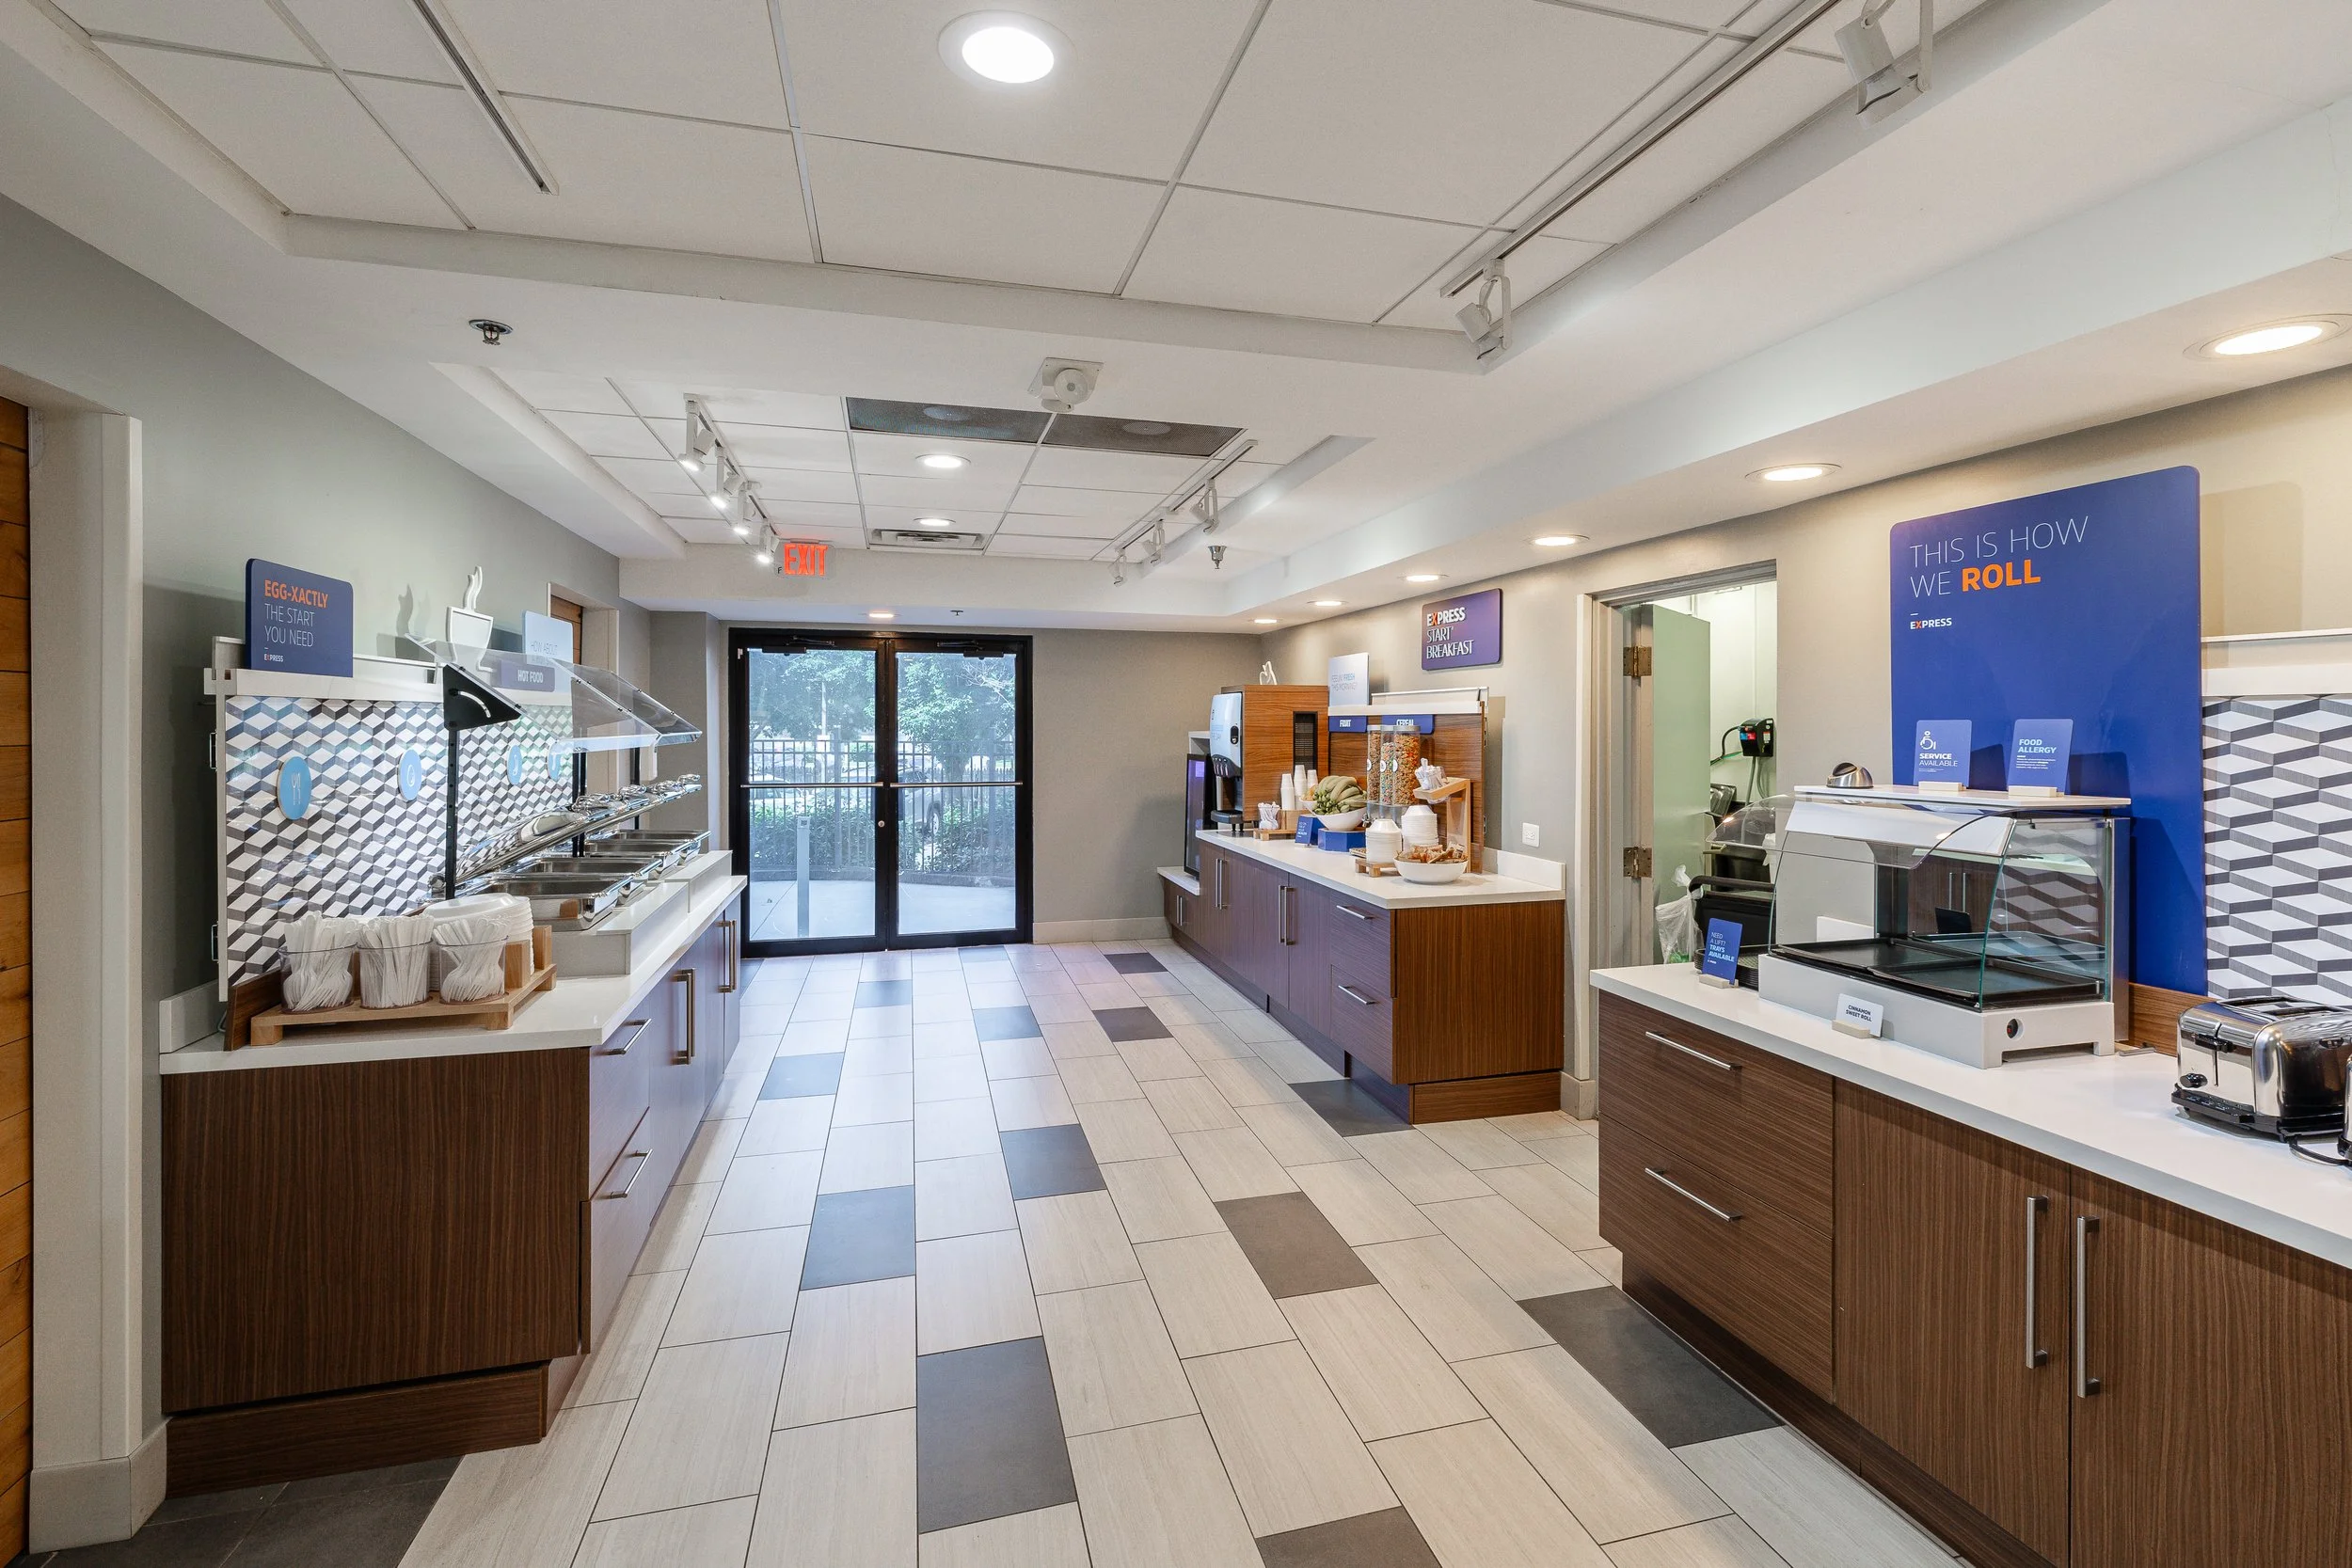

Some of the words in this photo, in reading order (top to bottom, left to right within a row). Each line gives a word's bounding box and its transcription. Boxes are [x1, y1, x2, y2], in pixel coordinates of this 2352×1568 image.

[1910, 537, 1964, 567] THIS
[1977, 531, 1998, 559] IS
[2010, 515, 2089, 553] HOW
[784, 543, 828, 577] EXIT
[1910, 571, 1951, 598] WE
[1962, 559, 2042, 593] ROLL
[264, 579, 328, 608] EGG-XACTLY
[264, 603, 284, 622] THE
[287, 607, 315, 627] START
[1426, 607, 1466, 626] EXPRESS
[1910, 617, 1952, 630] EXPRESS
[264, 626, 286, 644] YOU
[289, 628, 314, 647] NEED
[1426, 639, 1474, 659] BREAKFAST
[263, 653, 284, 662] EXPRESS
[517, 670, 529, 682] HOT
[530, 671, 544, 683] FOOD
[1339, 719, 1352, 727] FRUIT
[1709, 943, 1725, 953] TRAYS
[1708, 951, 1735, 962] AVAILABLE
[1846, 1009, 1860, 1018] SWEET
[1848, 1005, 1871, 1016] CINNAMON
